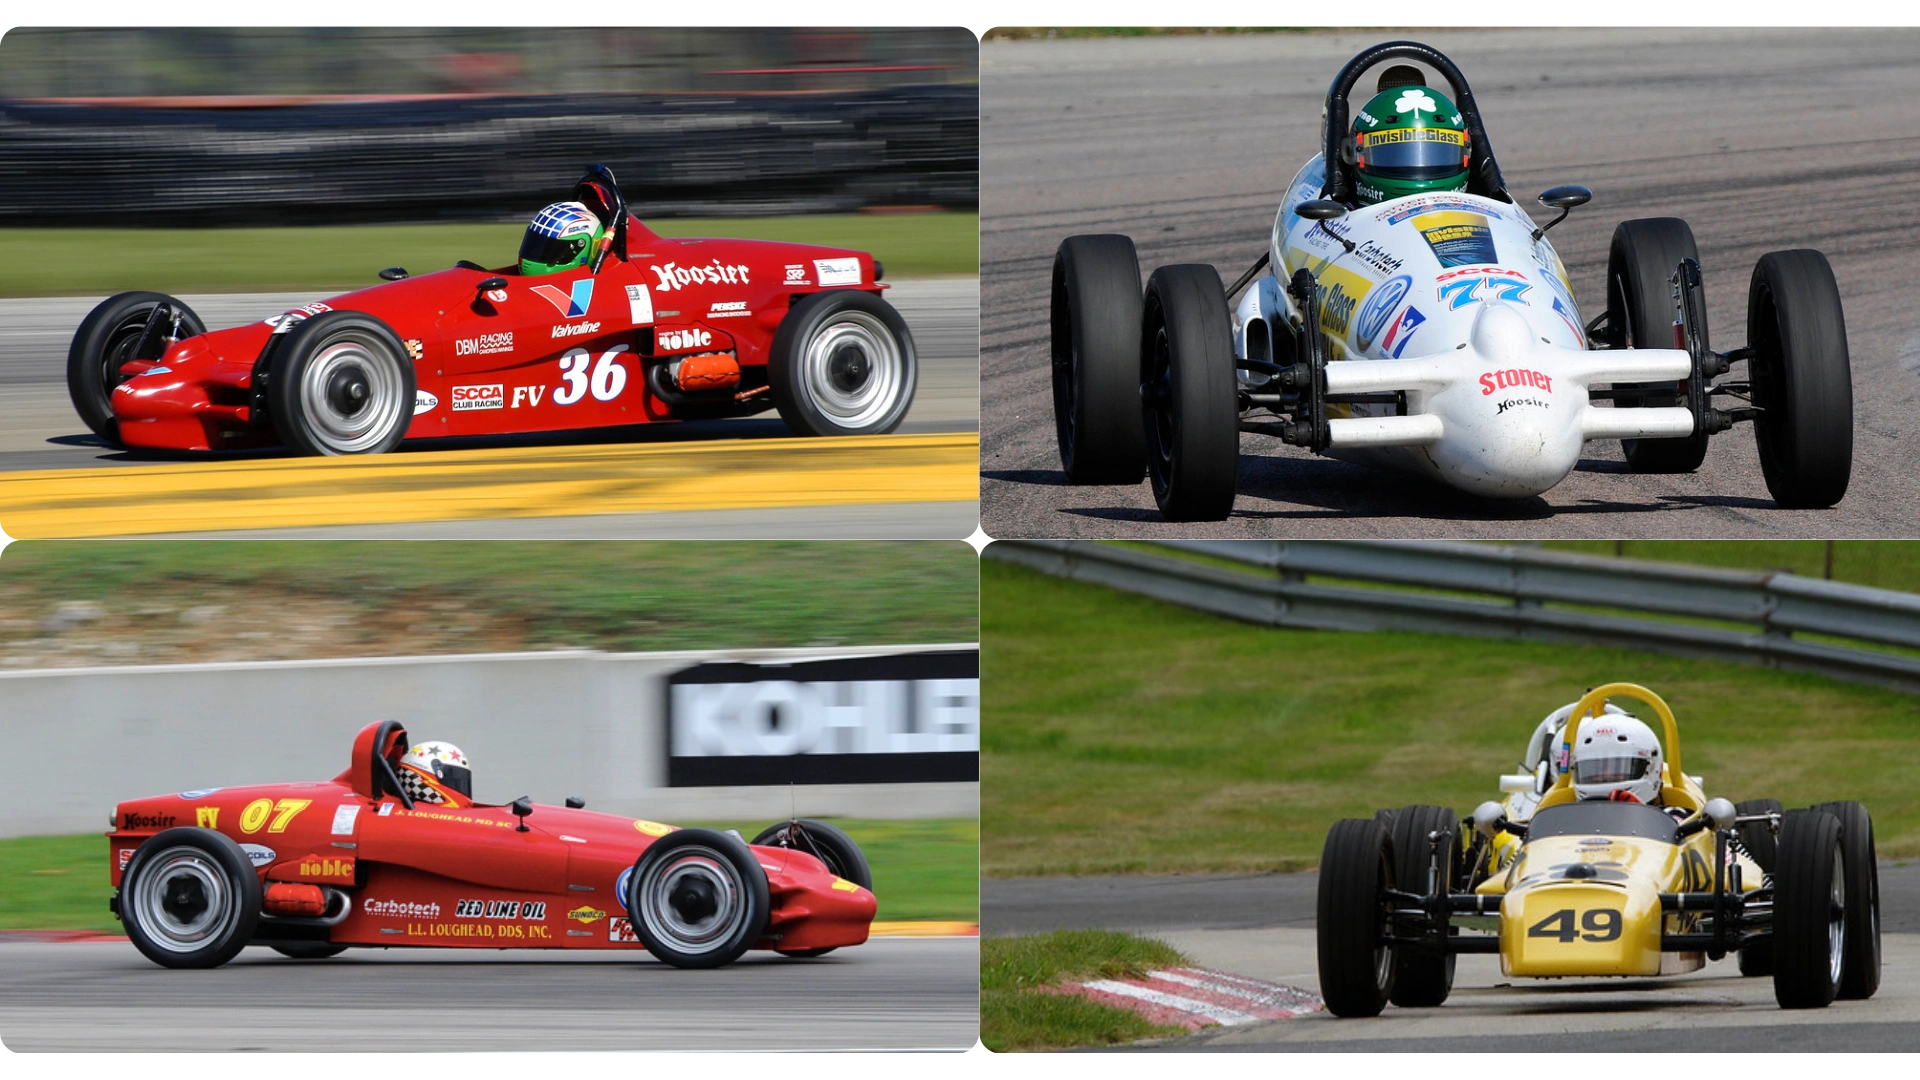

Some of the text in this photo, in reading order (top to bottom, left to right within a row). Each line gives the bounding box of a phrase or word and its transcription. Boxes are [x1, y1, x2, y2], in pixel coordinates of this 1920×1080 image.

[650, 258, 750, 292] Hoosier
[1436, 267, 1529, 282] SCCA
[1437, 277, 1533, 311] 77
[479, 332, 513, 344] RACING
[551, 321, 601, 338] Valvoline
[455, 338, 479, 356] DBM
[552, 343, 630, 407] 36
[1478, 368, 1552, 396] Stoner
[453, 386, 502, 400] SCCA
[510, 385, 546, 408] FV
[453, 399, 503, 409] CLUB RACING
[1496, 396, 1550, 416] Hoosier
[196, 806, 220, 829] FV
[239, 798, 313, 834] 07
[407, 811, 473, 823] LOUGHEAD
[300, 859, 353, 877] noble
[364, 897, 441, 916] Carbotech
[455, 899, 546, 920] RED LINE OIL
[569, 911, 605, 919] SUNOCO
[407, 923, 428, 936] L.L.
[430, 923, 495, 939] LOUGHEAD,
[498, 925, 526, 939] DDS,
[1527, 908, 1623, 943] 49
